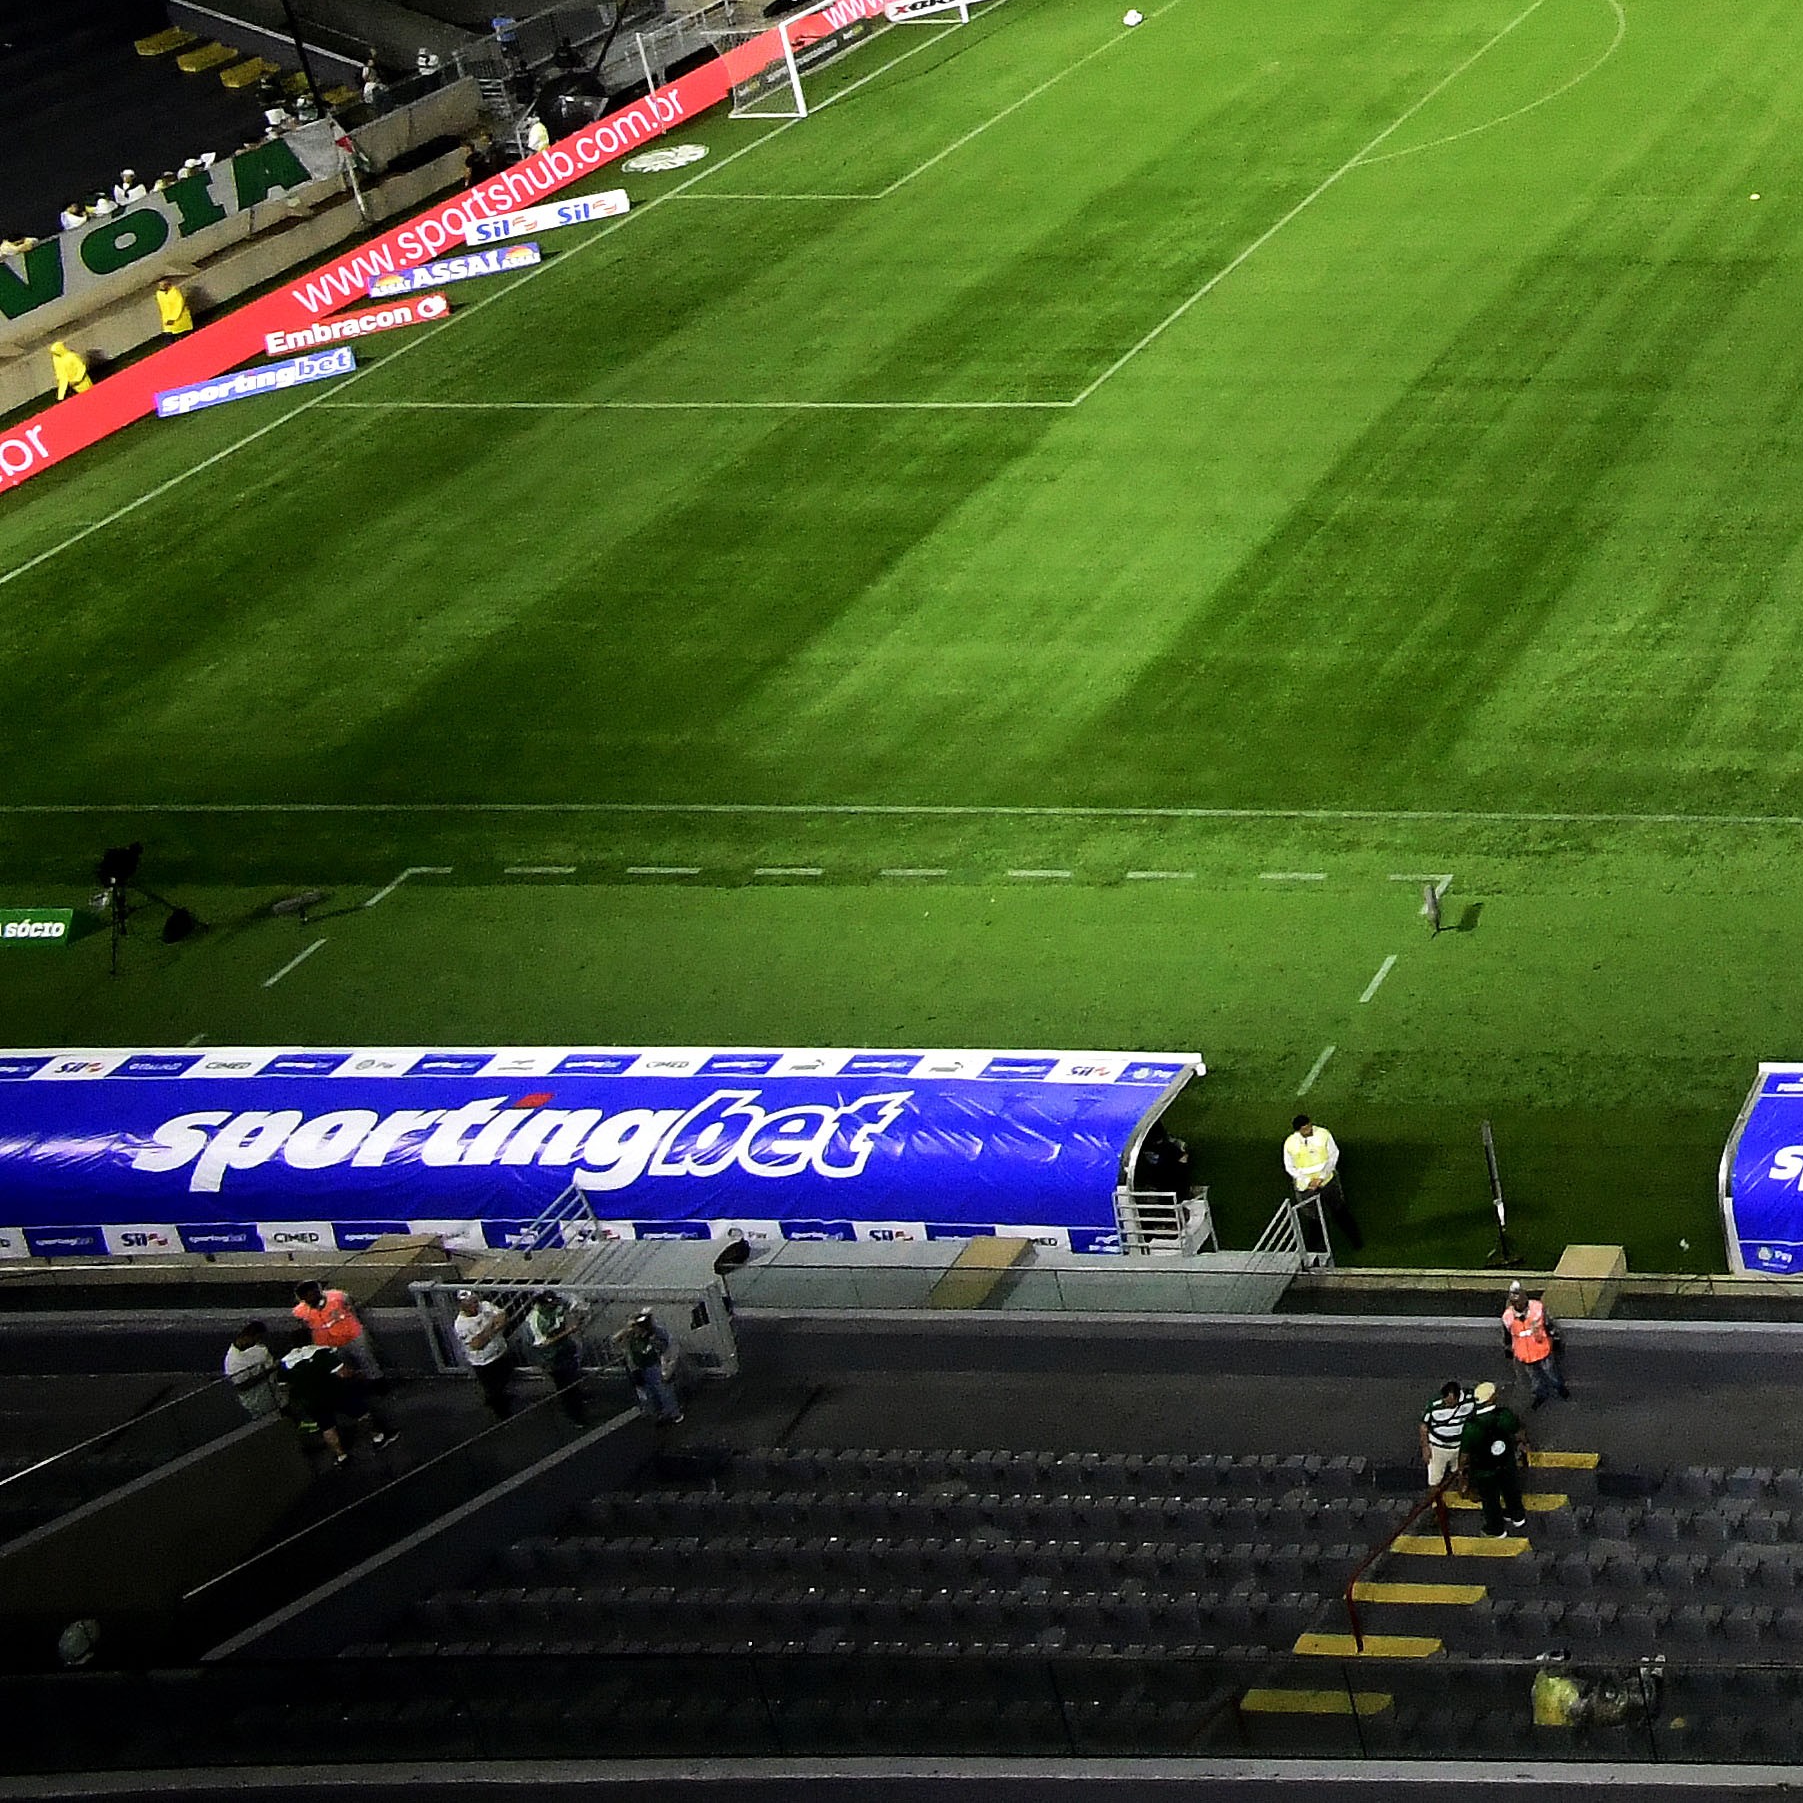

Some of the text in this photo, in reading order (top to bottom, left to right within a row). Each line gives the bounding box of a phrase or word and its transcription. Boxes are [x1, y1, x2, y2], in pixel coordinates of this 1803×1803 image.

[476, 201, 591, 243] Sil Sil
[266, 306, 413, 354] Embracon
[161, 347, 352, 415] sportingbet
[131, 1090, 915, 1193] sportingbet
